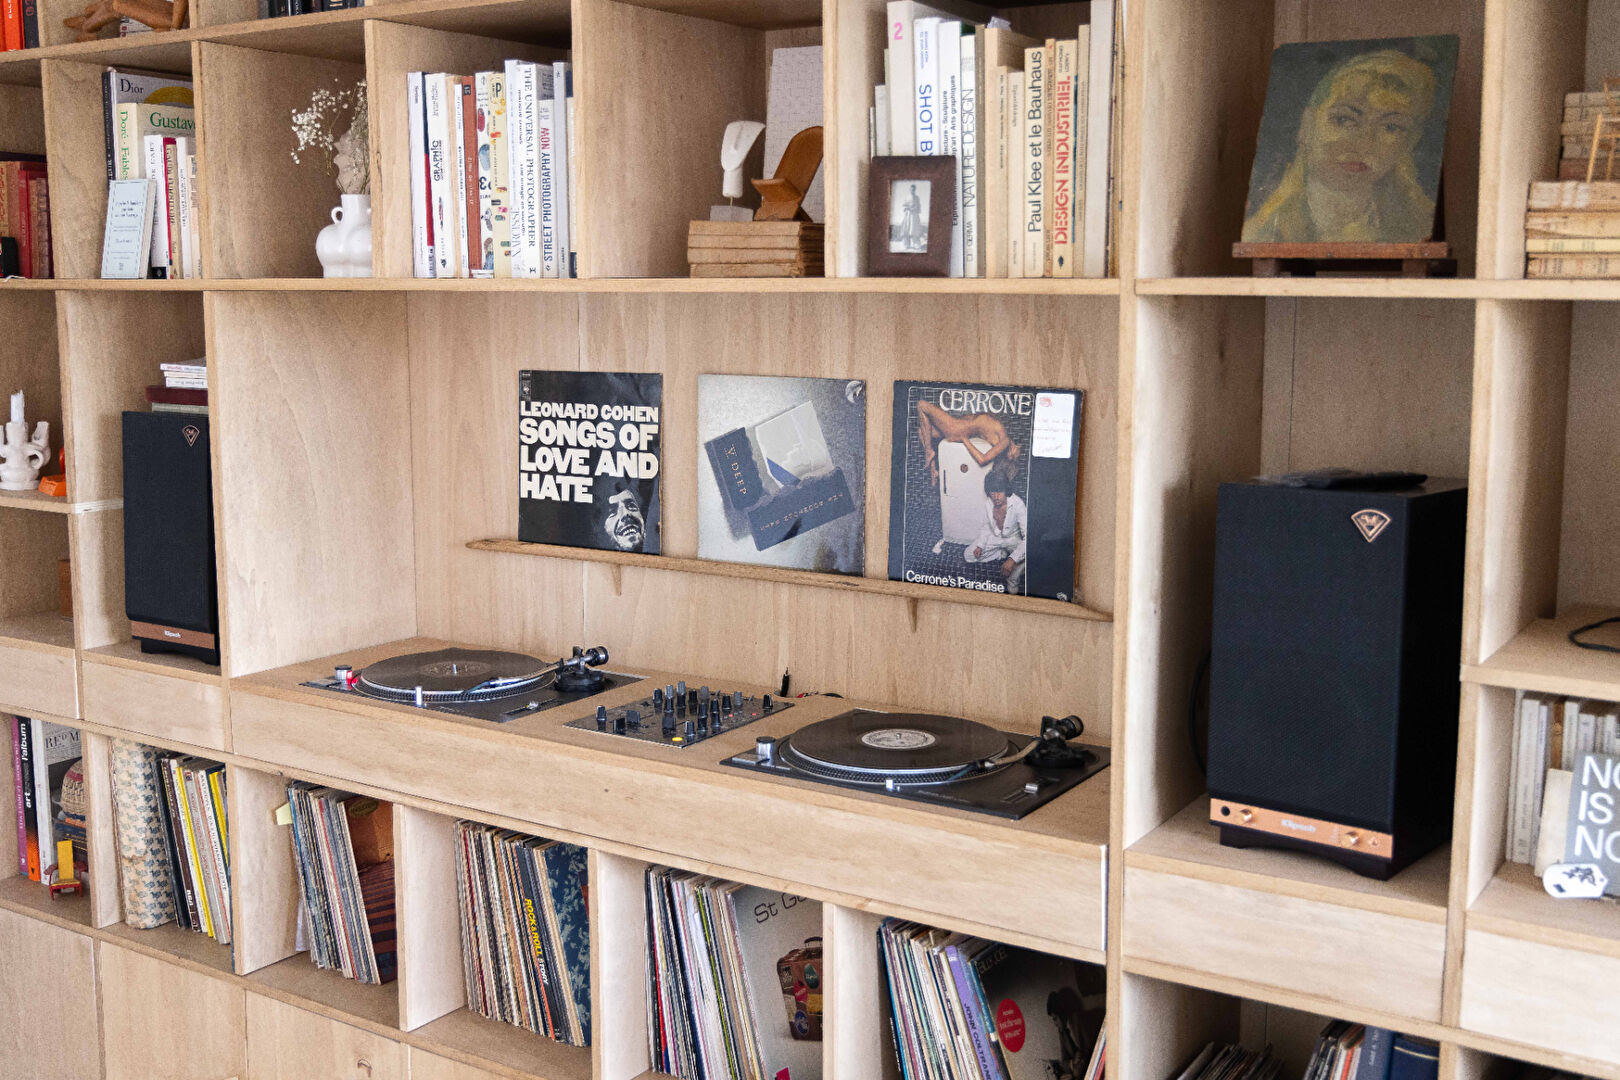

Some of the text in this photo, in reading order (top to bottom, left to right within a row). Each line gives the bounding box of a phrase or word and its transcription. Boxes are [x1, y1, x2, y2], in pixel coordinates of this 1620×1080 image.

[893, 22, 903, 40] 2
[120, 79, 144, 94] Dior
[120, 111, 129, 138] Doré
[919, 84, 933, 134] SHOT
[540, 127, 551, 150] NOW
[961, 88, 976, 208] NATURE DESIGN
[1027, 51, 1042, 233] Paul Klee et le Bauhaus
[524, 67, 536, 248] THE UNIVERSAL PHOTOGRAPHER
[1054, 75, 1071, 245] DESIGN INDUSTRIEL
[541, 152, 553, 222] PHOTOGRAPHY
[543, 225, 553, 262] STREET
[520, 400, 659, 423] LEONARD COHEN
[939, 389, 1031, 416] CERRONE
[519, 418, 659, 451] SONGS OF
[520, 445, 659, 480] LOVE AND
[731, 461, 748, 496] DEEP
[520, 472, 593, 504] HATE
[905, 569, 1005, 594] Cerrone's Paradise
[1582, 755, 1620, 790] N
[1578, 790, 1614, 825] IS
[754, 902, 779, 924] St
[963, 1003, 977, 1030] JOHN
